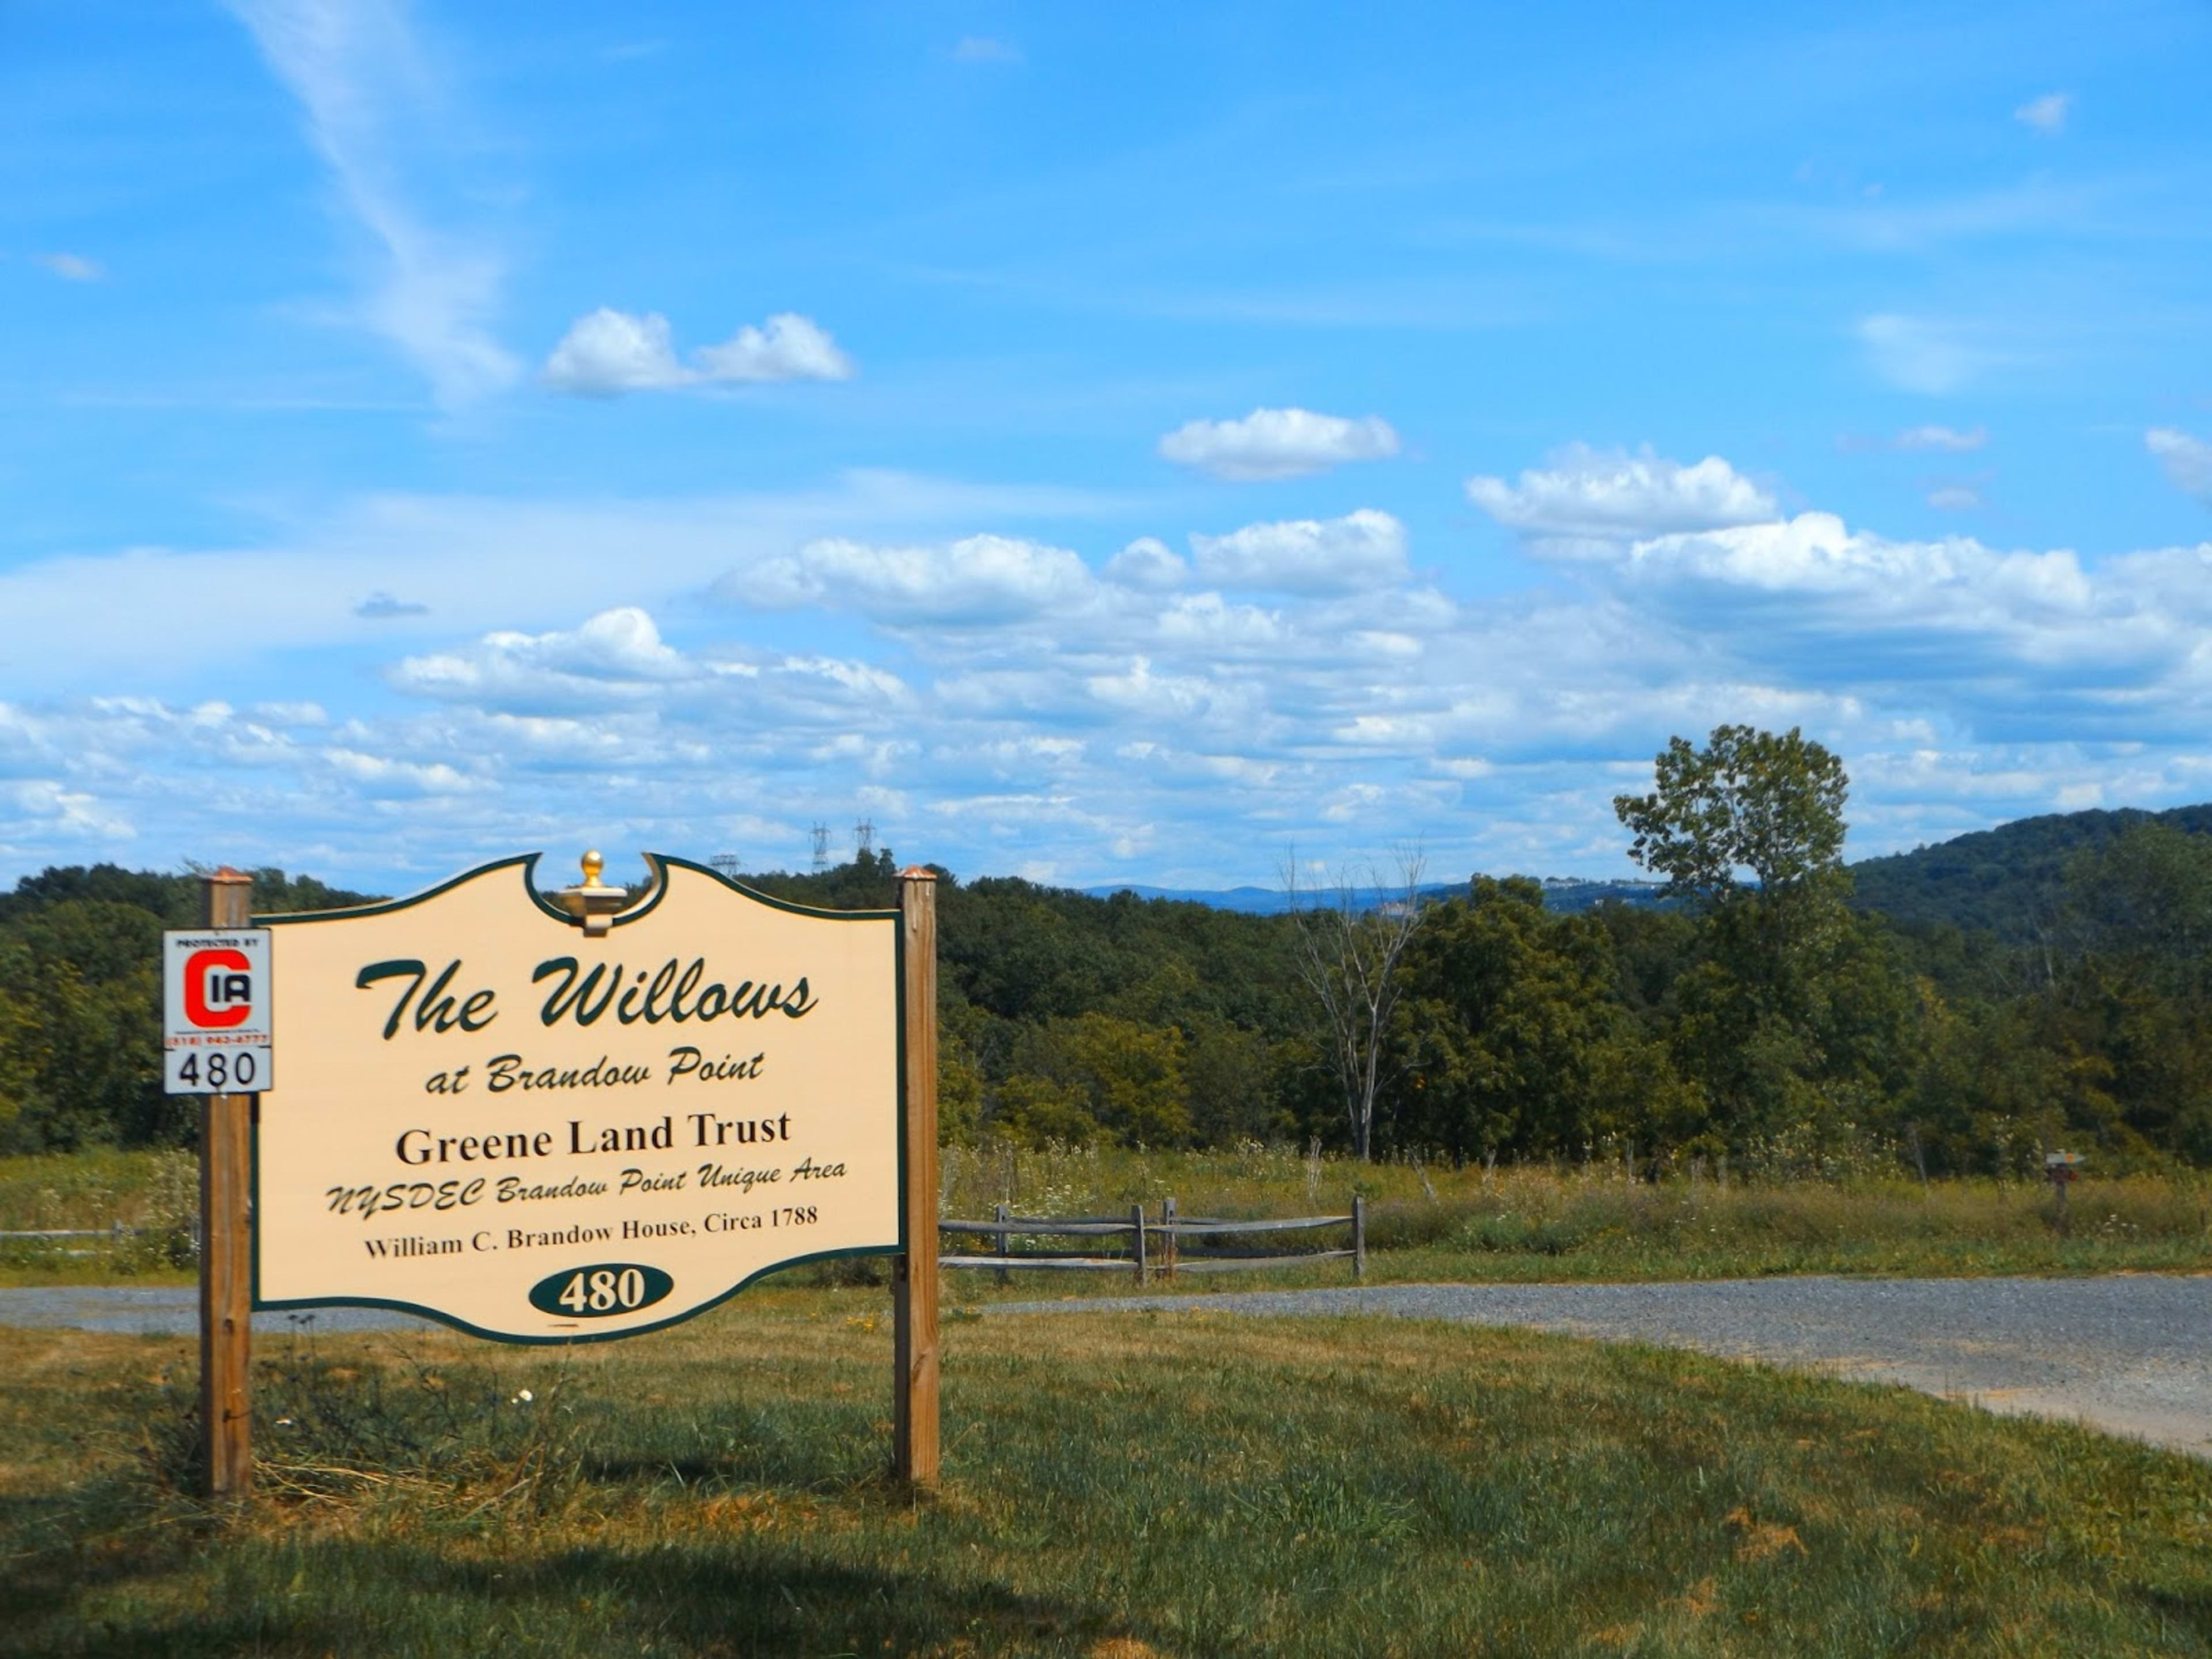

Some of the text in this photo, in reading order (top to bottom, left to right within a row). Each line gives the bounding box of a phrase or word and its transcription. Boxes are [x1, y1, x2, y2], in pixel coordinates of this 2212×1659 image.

[176, 938, 258, 948] PROTECTED BY
[184, 949, 251, 1028] CIA
[355, 956, 819, 1041] The Willows
[180, 1052, 255, 1086] 480
[425, 1046, 765, 1095] at Brandow Point
[395, 1112, 792, 1165] Greene Land Trust
[325, 1156, 847, 1221] NYSDEC Brandow Point Unique Area
[363, 1206, 819, 1259] William C. Brandow House, Circa 1788
[559, 1268, 646, 1312] 480
